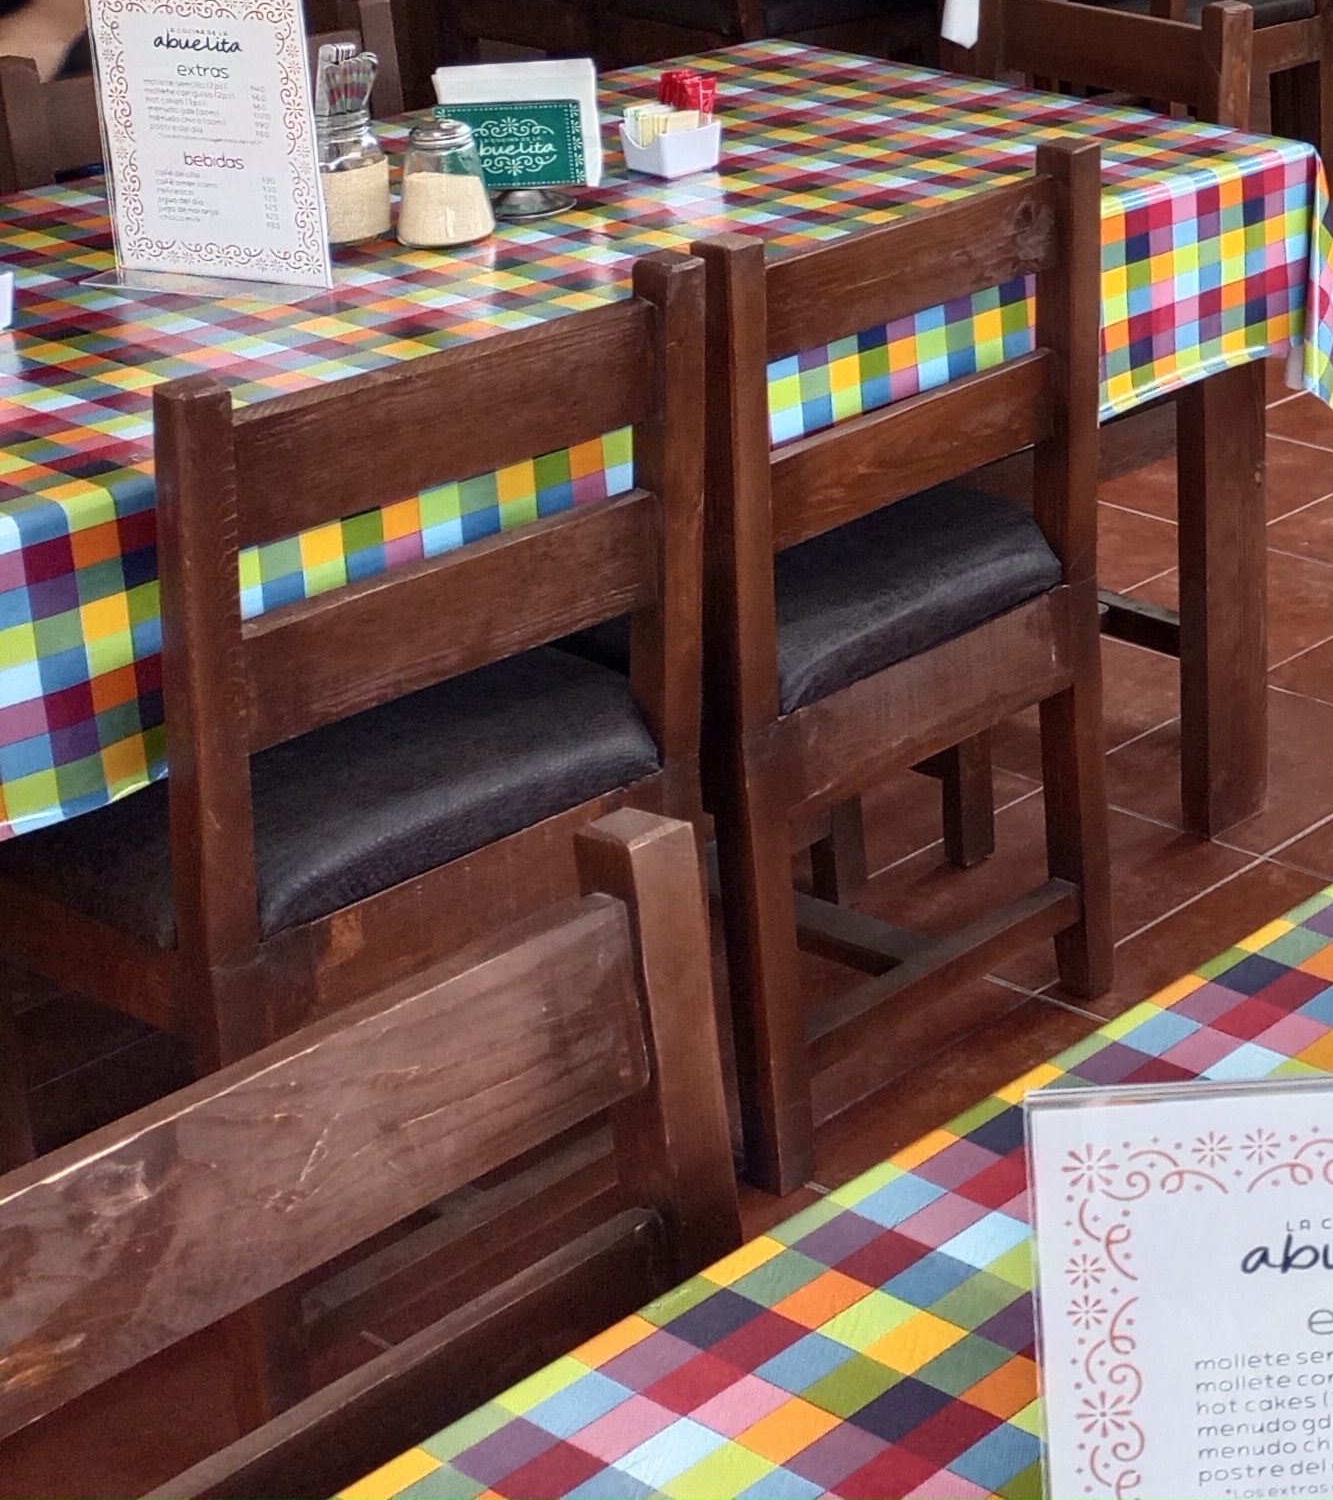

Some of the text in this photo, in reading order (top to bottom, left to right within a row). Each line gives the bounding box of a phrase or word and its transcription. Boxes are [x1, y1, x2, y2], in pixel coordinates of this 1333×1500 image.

[153, 31, 244, 53] abuelita
[177, 64, 229, 79] extras
[479, 138, 557, 157] buelita
[183, 151, 244, 170] bebidas
[1286, 1219, 1311, 1232] LA
[1195, 1352, 1291, 1371] mollete
[1195, 1374, 1291, 1393] mollete
[1197, 1400, 1238, 1415] hot
[1245, 1396, 1316, 1413] cakes
[1198, 1418, 1296, 1437] menudo
[1198, 1440, 1297, 1459] menudo
[1199, 1464, 1284, 1487] postre
[1290, 1458, 1326, 1476] del
[1268, 1484, 1329, 1498] extras
